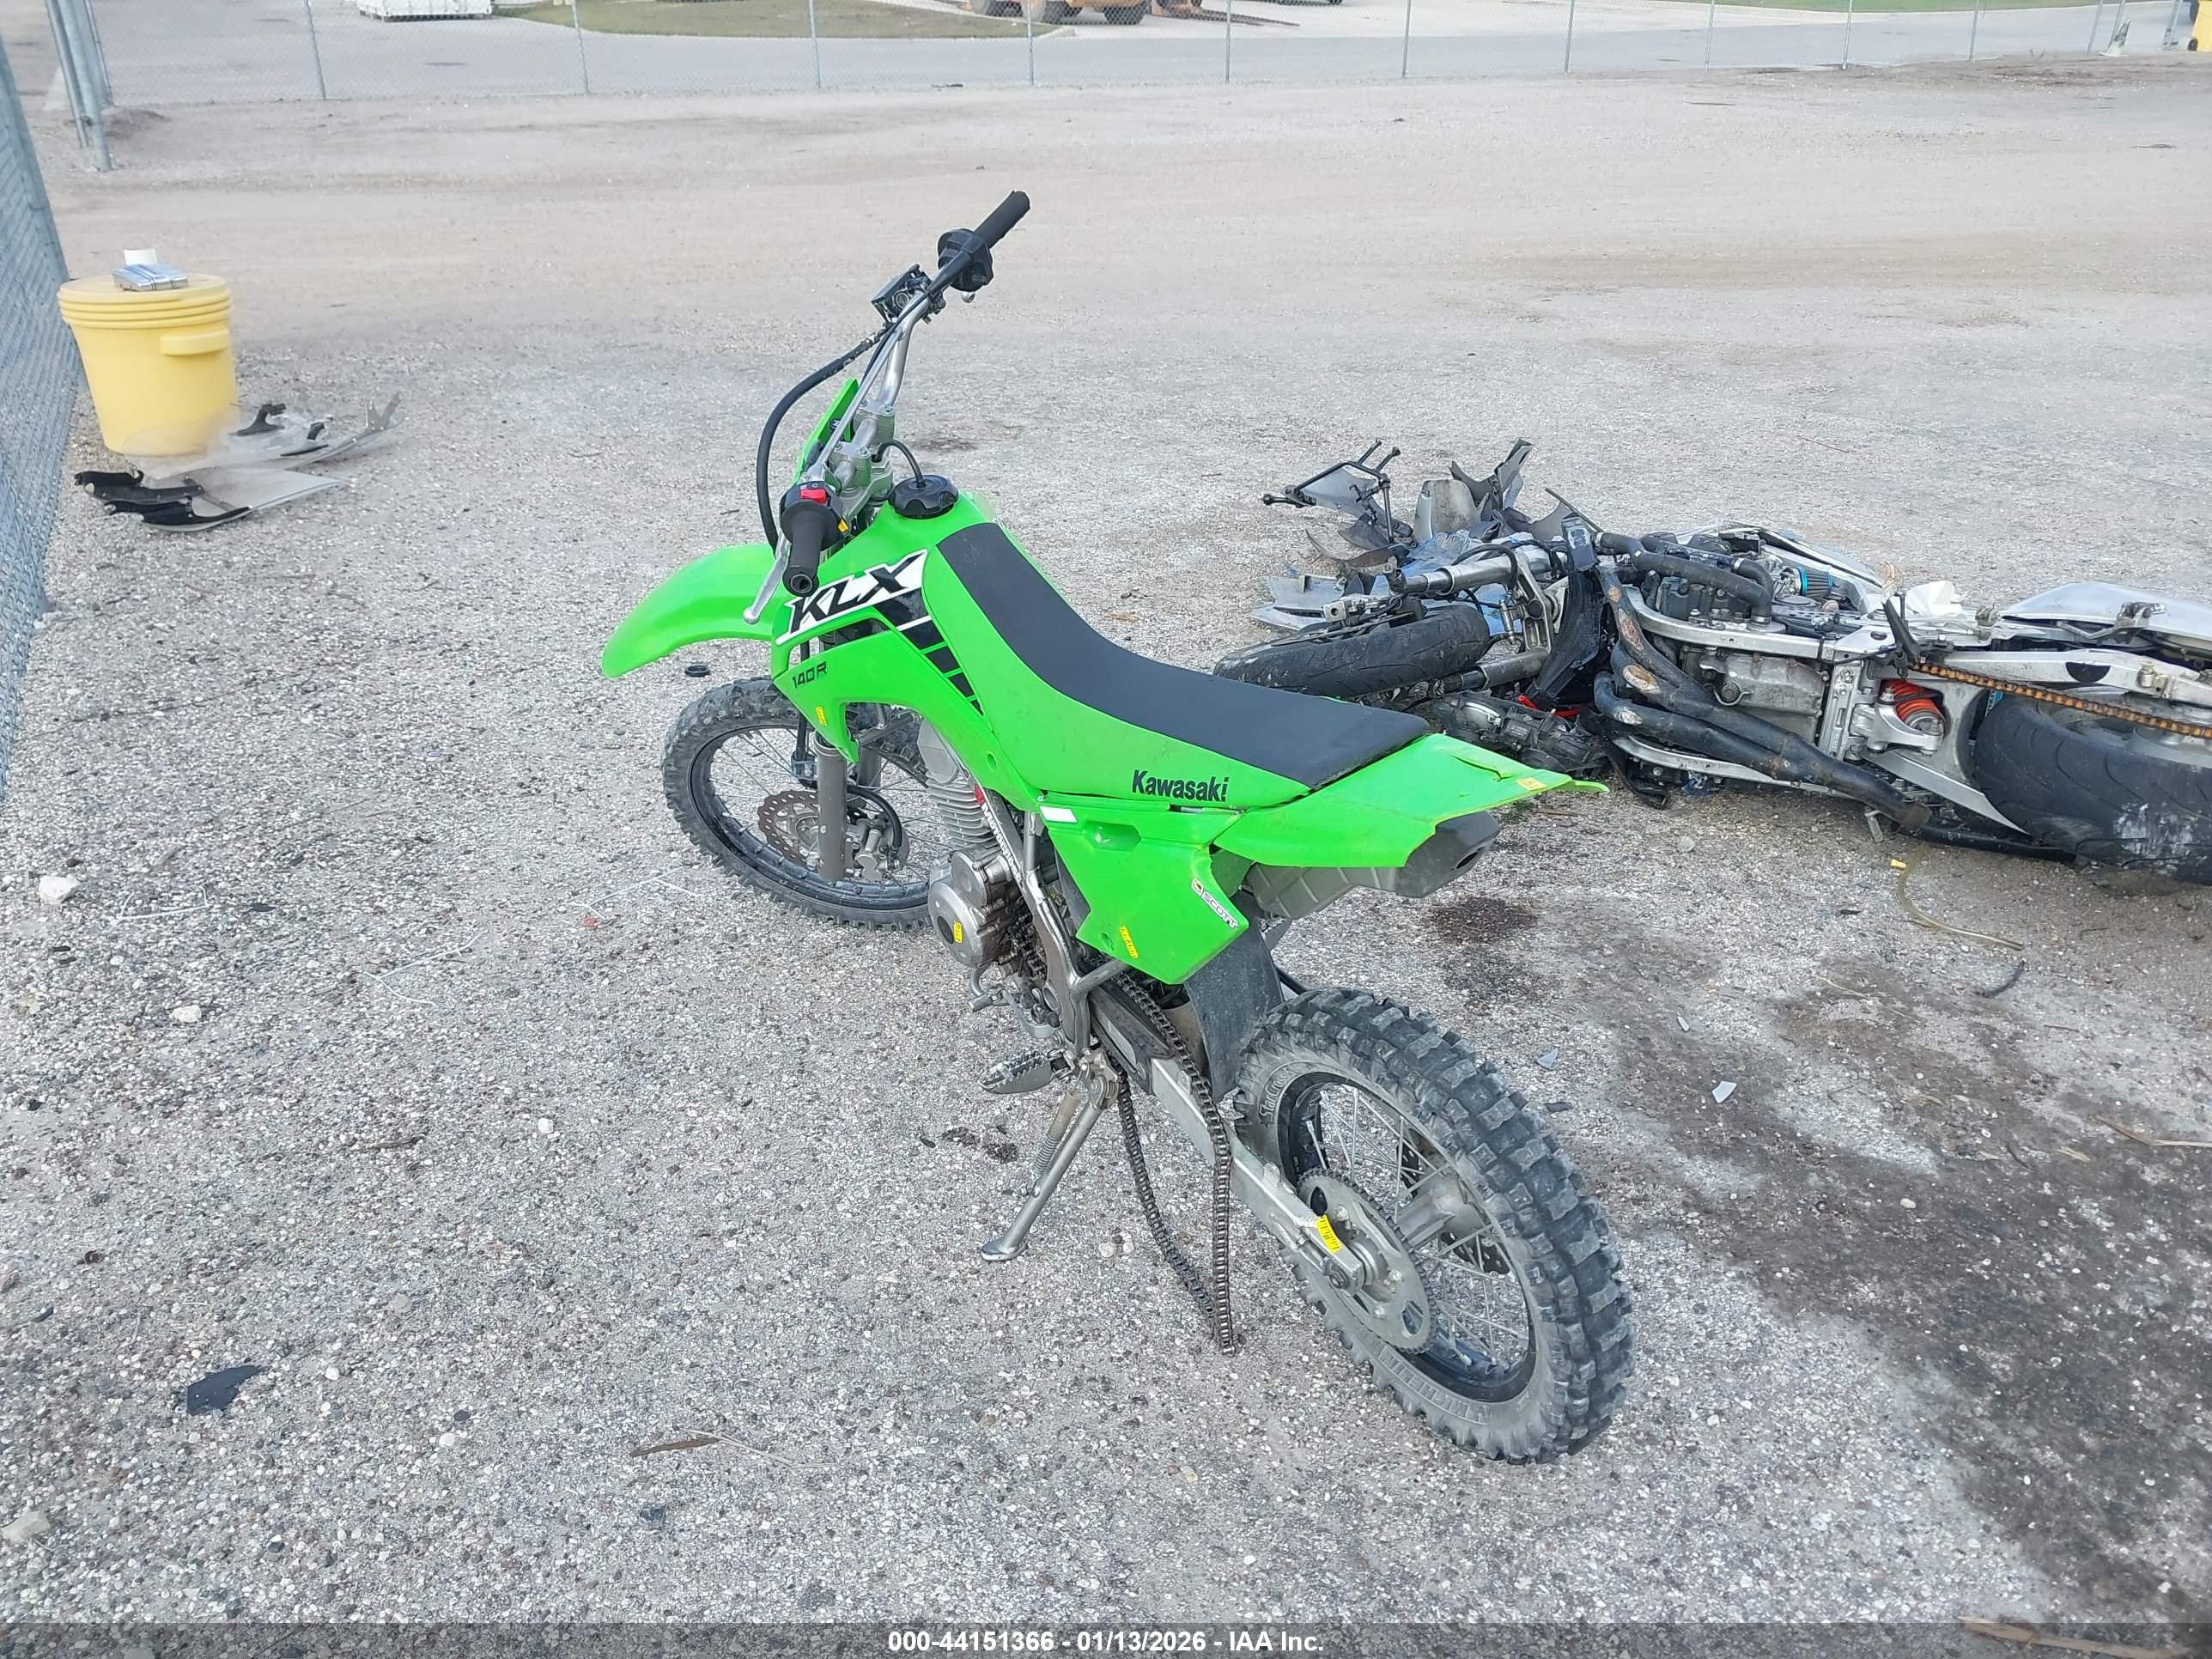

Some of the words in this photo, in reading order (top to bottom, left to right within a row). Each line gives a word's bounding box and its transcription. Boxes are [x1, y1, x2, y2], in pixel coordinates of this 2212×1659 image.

[789, 552, 925, 635] KLX
[1132, 769, 1230, 802] Kawasaki
[1377, 1348, 1471, 1418] MICHELIN
